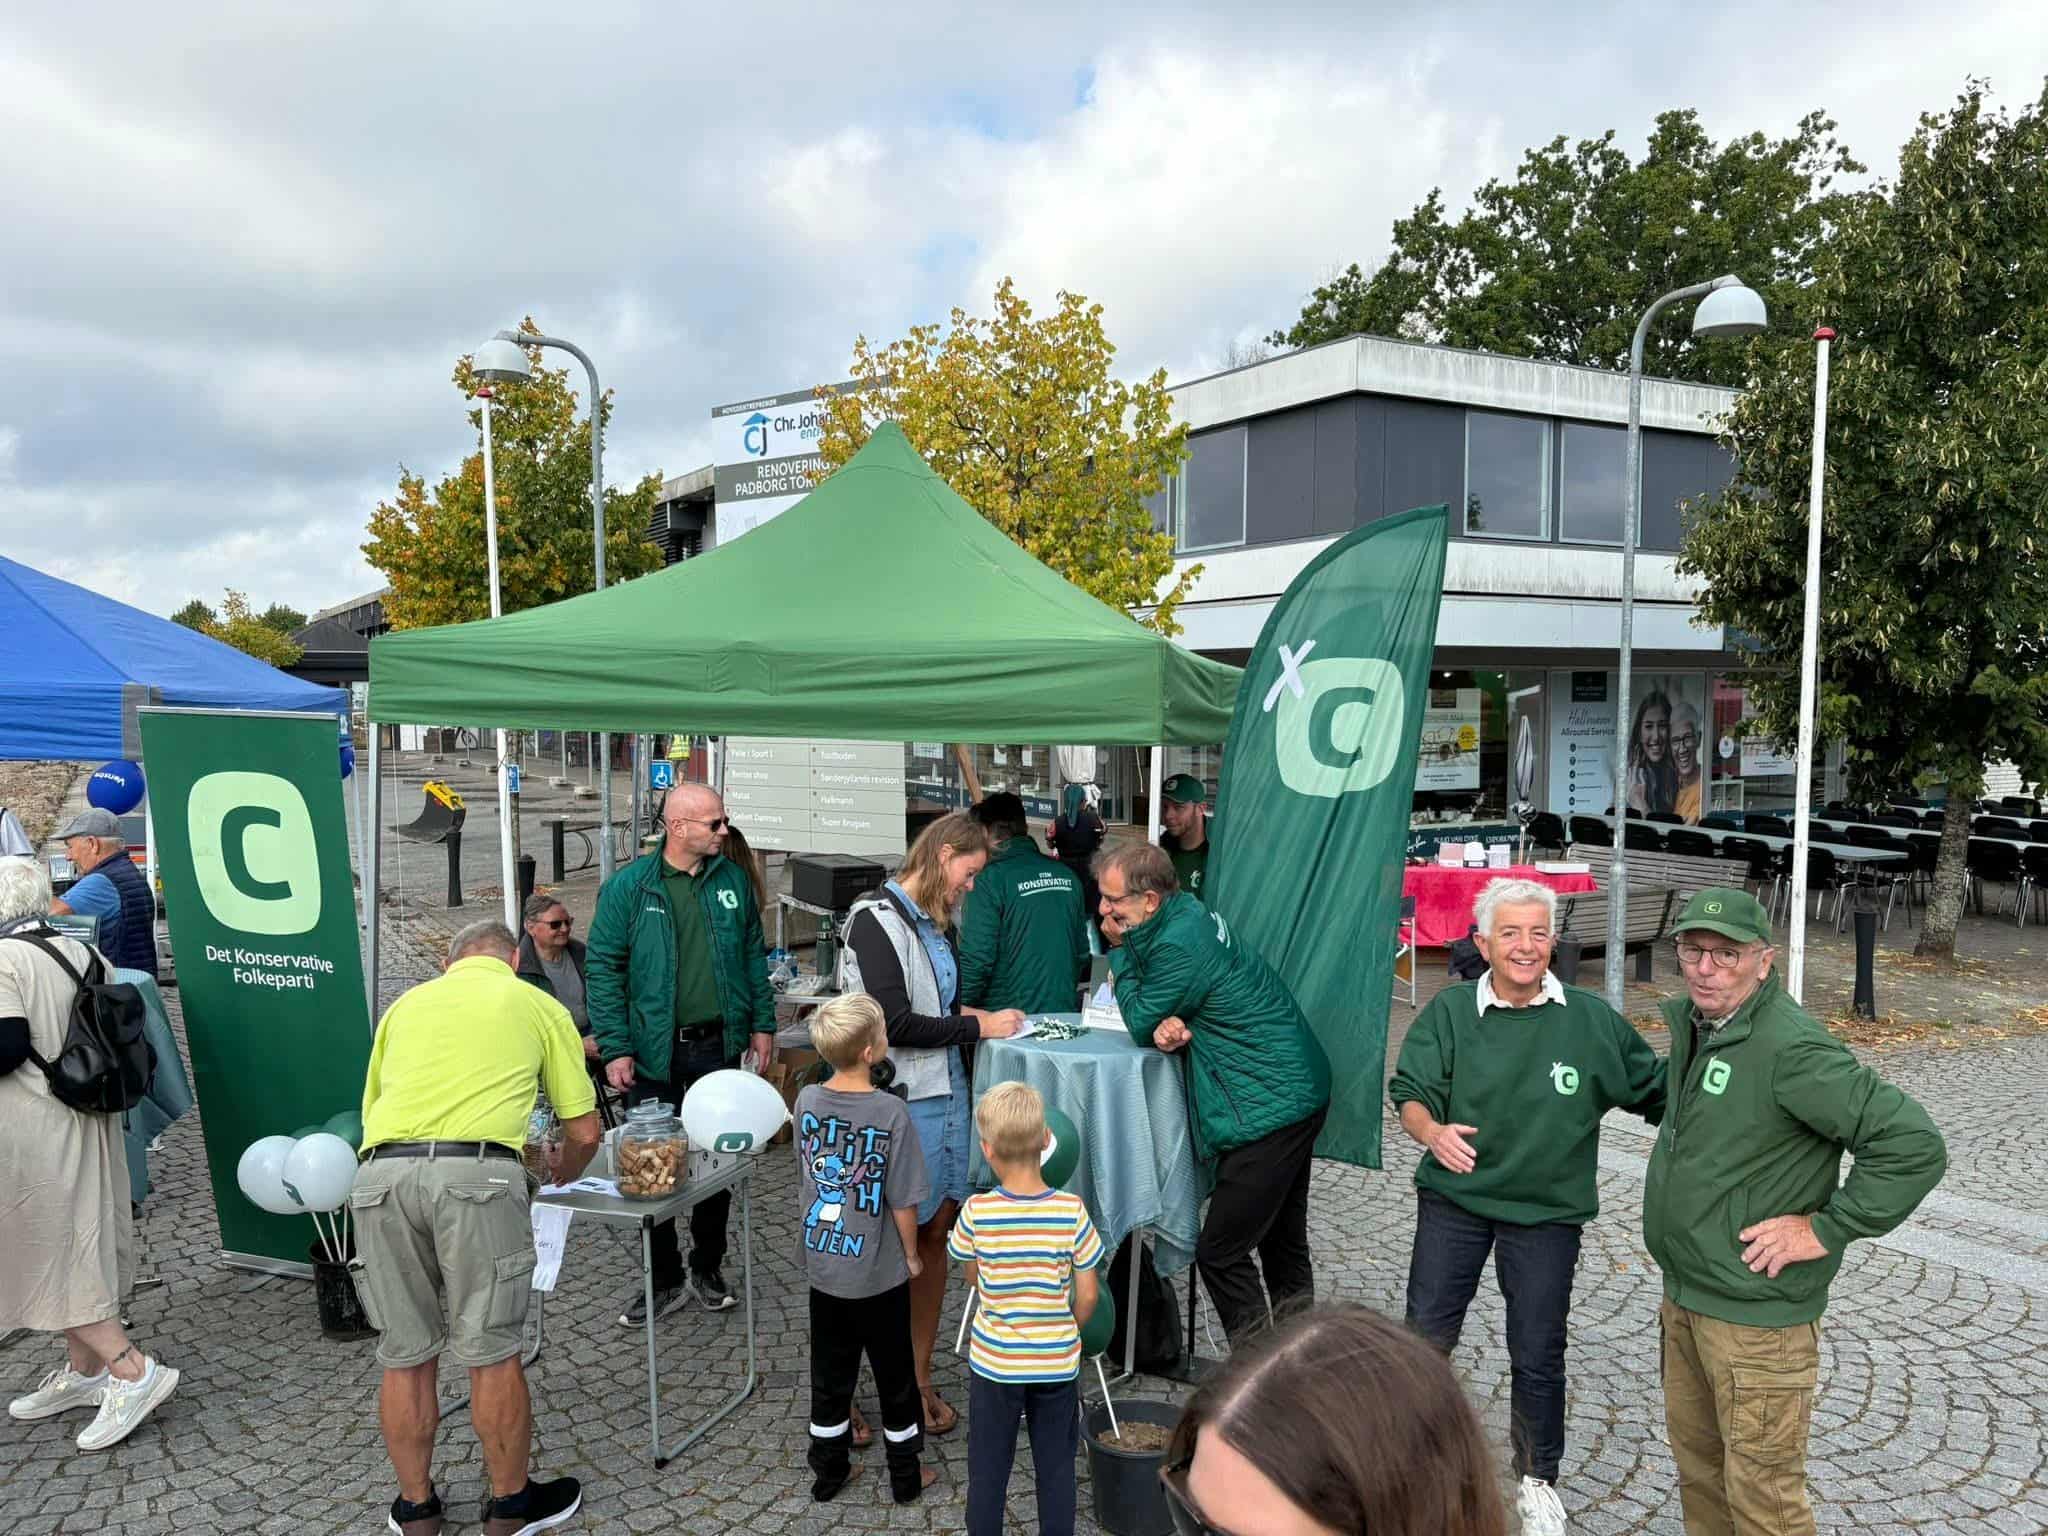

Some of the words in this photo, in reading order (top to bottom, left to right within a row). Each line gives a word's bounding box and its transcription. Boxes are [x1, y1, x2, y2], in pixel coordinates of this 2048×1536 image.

[774, 416, 796, 432] Chr.
[757, 458, 830, 479] RENOVERING
[735, 478, 787, 497] PADBORG
[789, 475, 817, 490] TOR
[871, 775, 900, 785] revision
[205, 944, 232, 964] Det
[234, 948, 334, 974] Konservative
[233, 967, 315, 992] Folkeparti
